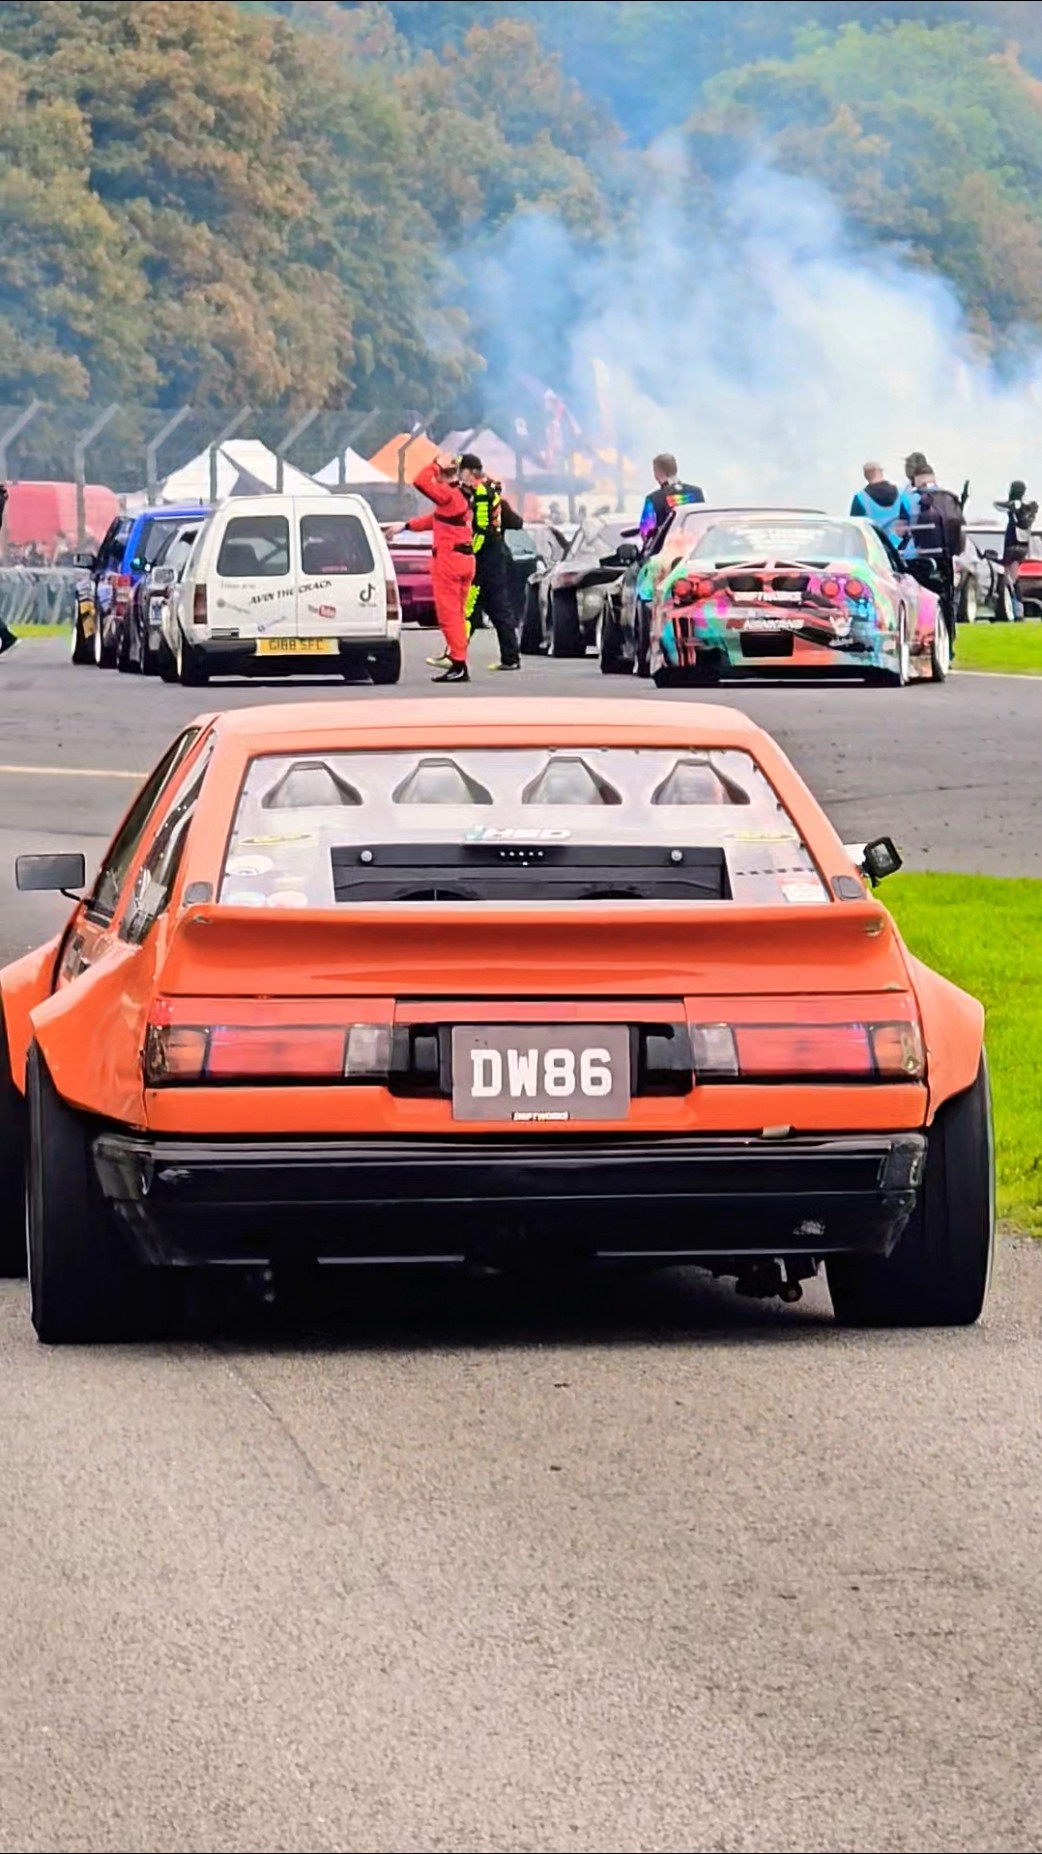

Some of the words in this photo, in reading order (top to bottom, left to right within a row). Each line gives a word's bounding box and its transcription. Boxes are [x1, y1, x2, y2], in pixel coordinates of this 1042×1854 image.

[277, 588, 294, 599] THE
[299, 580, 332, 593] CRACK
[470, 1048, 613, 1098] DW86
